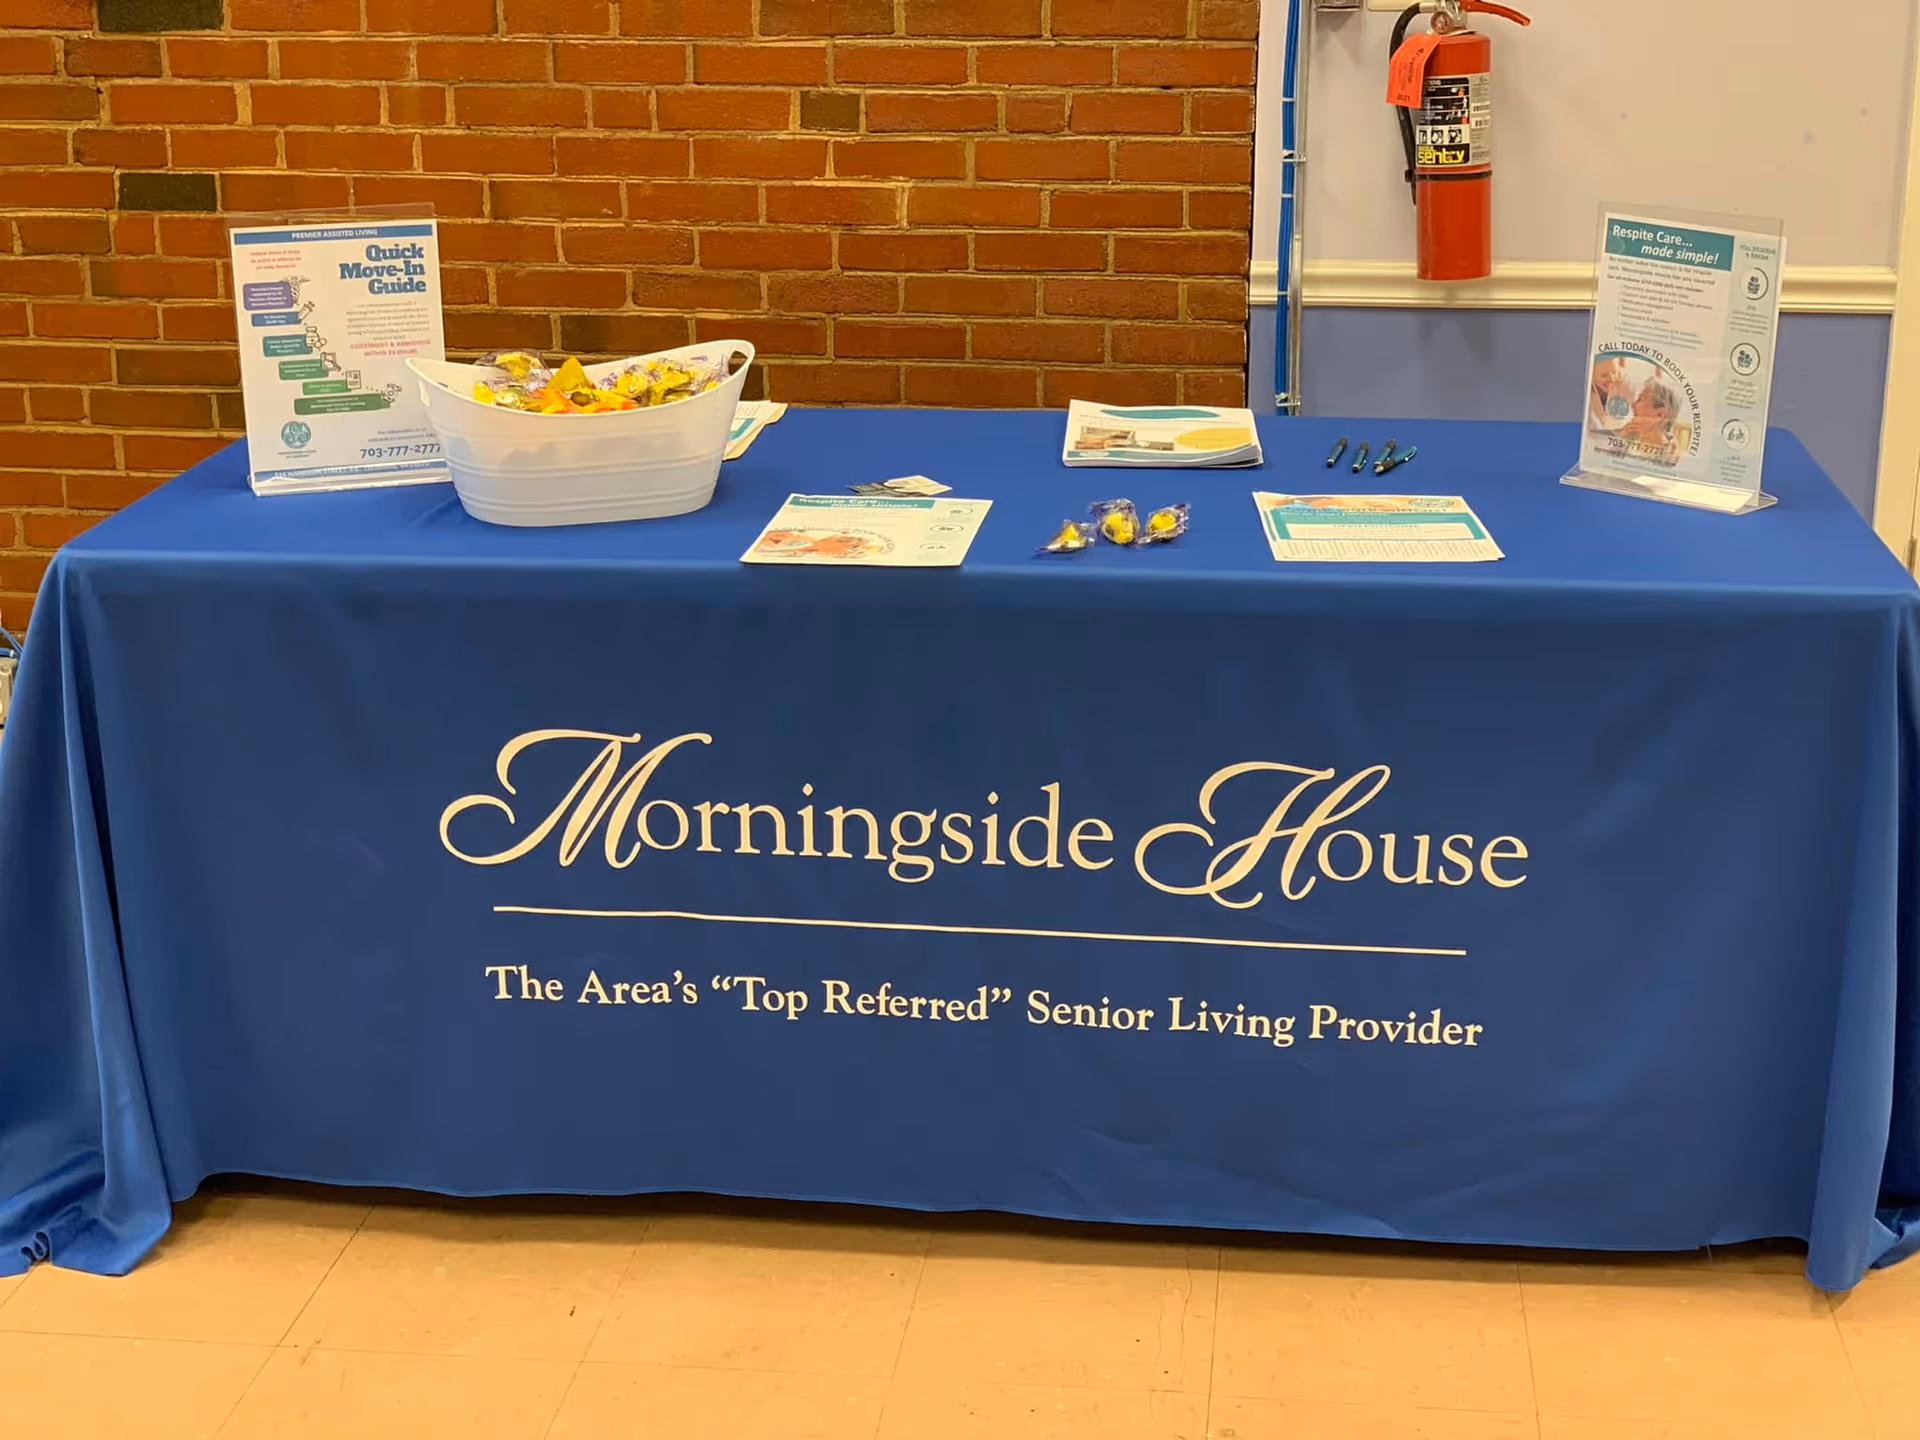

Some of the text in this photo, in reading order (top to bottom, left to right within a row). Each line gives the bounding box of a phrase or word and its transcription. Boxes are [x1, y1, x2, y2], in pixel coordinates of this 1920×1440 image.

[1418, 147, 1466, 164] sentry
[291, 228, 378, 239] PREMIER ASSISTED LIVING
[1612, 225, 1693, 247] Respite Care...
[365, 243, 425, 262] Quick
[1640, 244, 1720, 265] made simple!
[339, 260, 426, 279] Move-In
[368, 277, 427, 295] Guide
[1598, 341, 1702, 457] CALL TODAY TO BOOK YOUR RESPITE!
[360, 443, 441, 459] 703-777-2777
[439, 729, 1529, 910] Morningside House
[485, 964, 1484, 1049] The Area’s “Top Referred” Senior Living Provider
